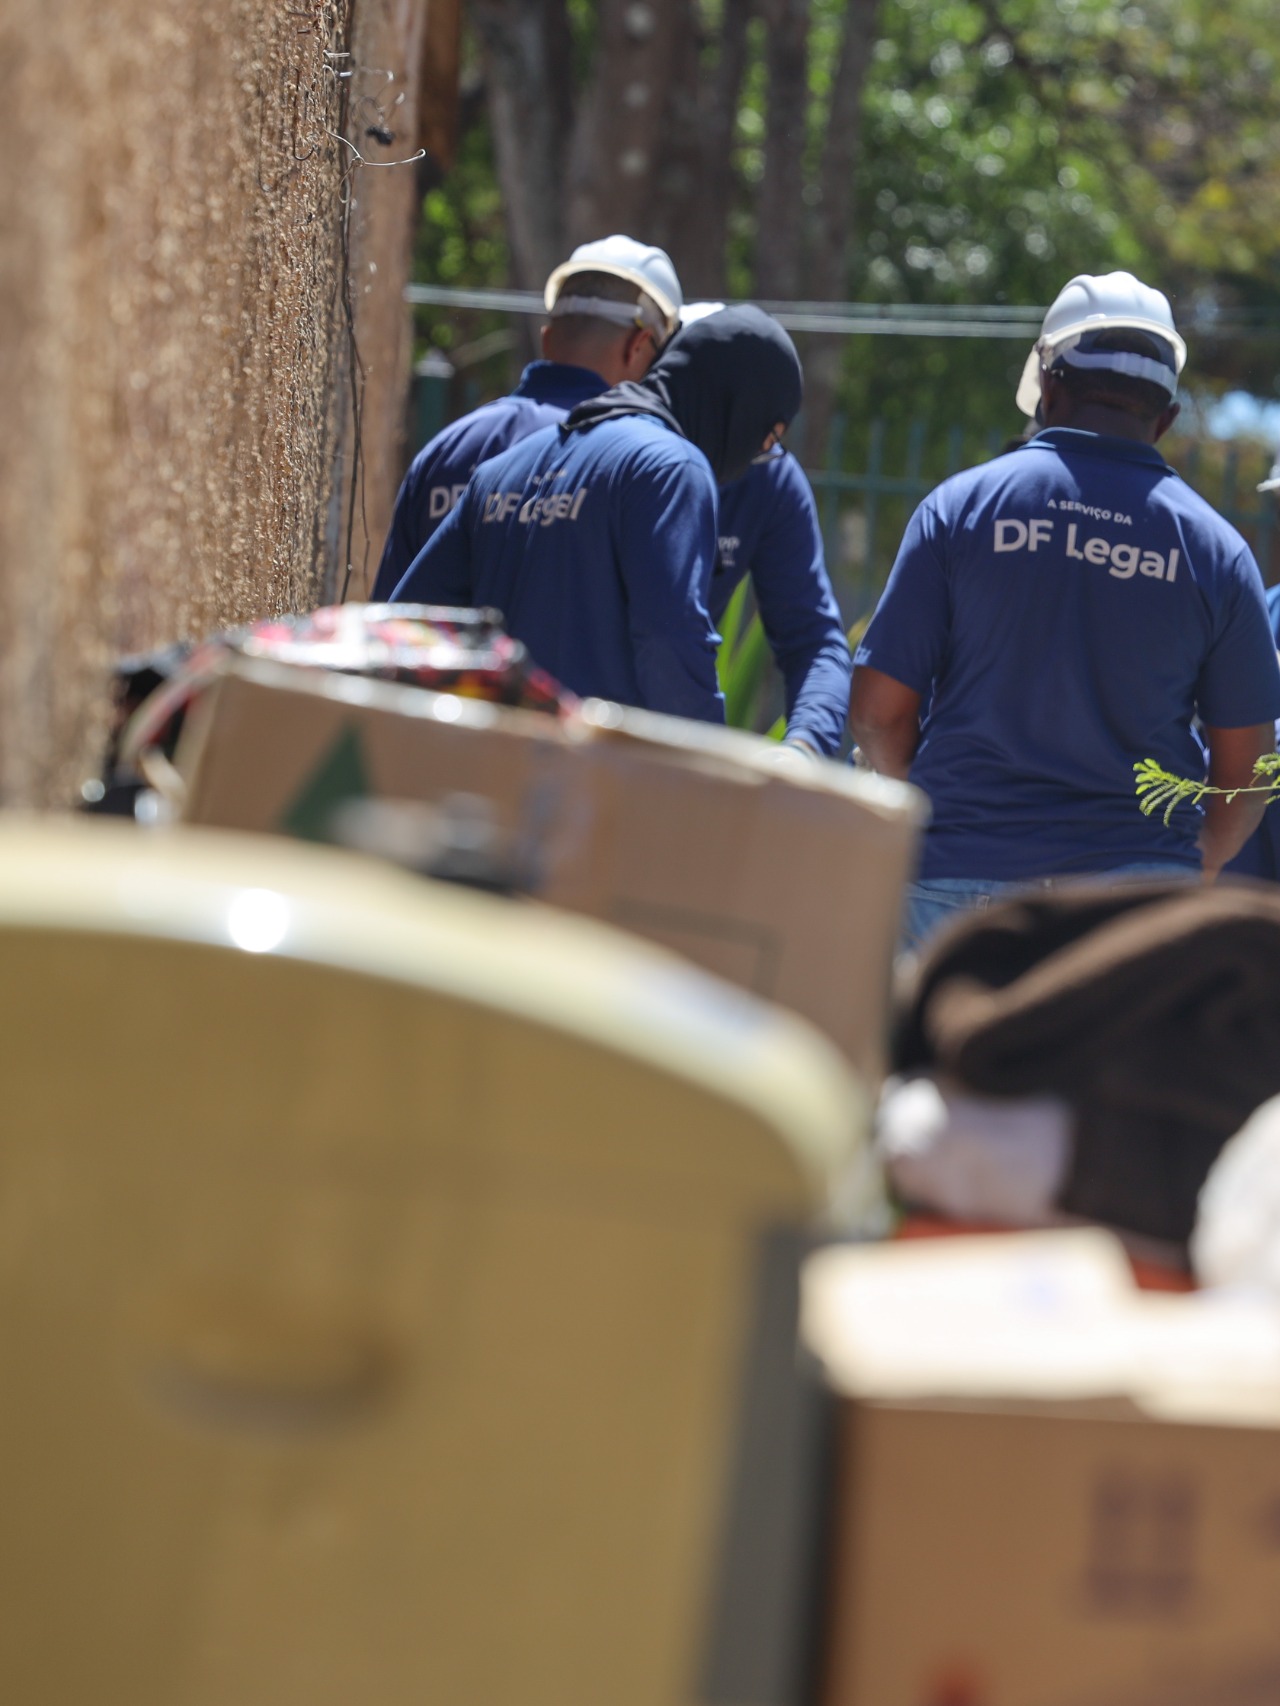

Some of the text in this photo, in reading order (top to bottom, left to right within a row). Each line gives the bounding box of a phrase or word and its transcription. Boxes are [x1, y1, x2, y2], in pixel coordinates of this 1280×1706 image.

[482, 487, 588, 526] DF Legal
[1047, 499, 1132, 526] A SERVIÇO DA
[993, 519, 1180, 582] DF Legal
